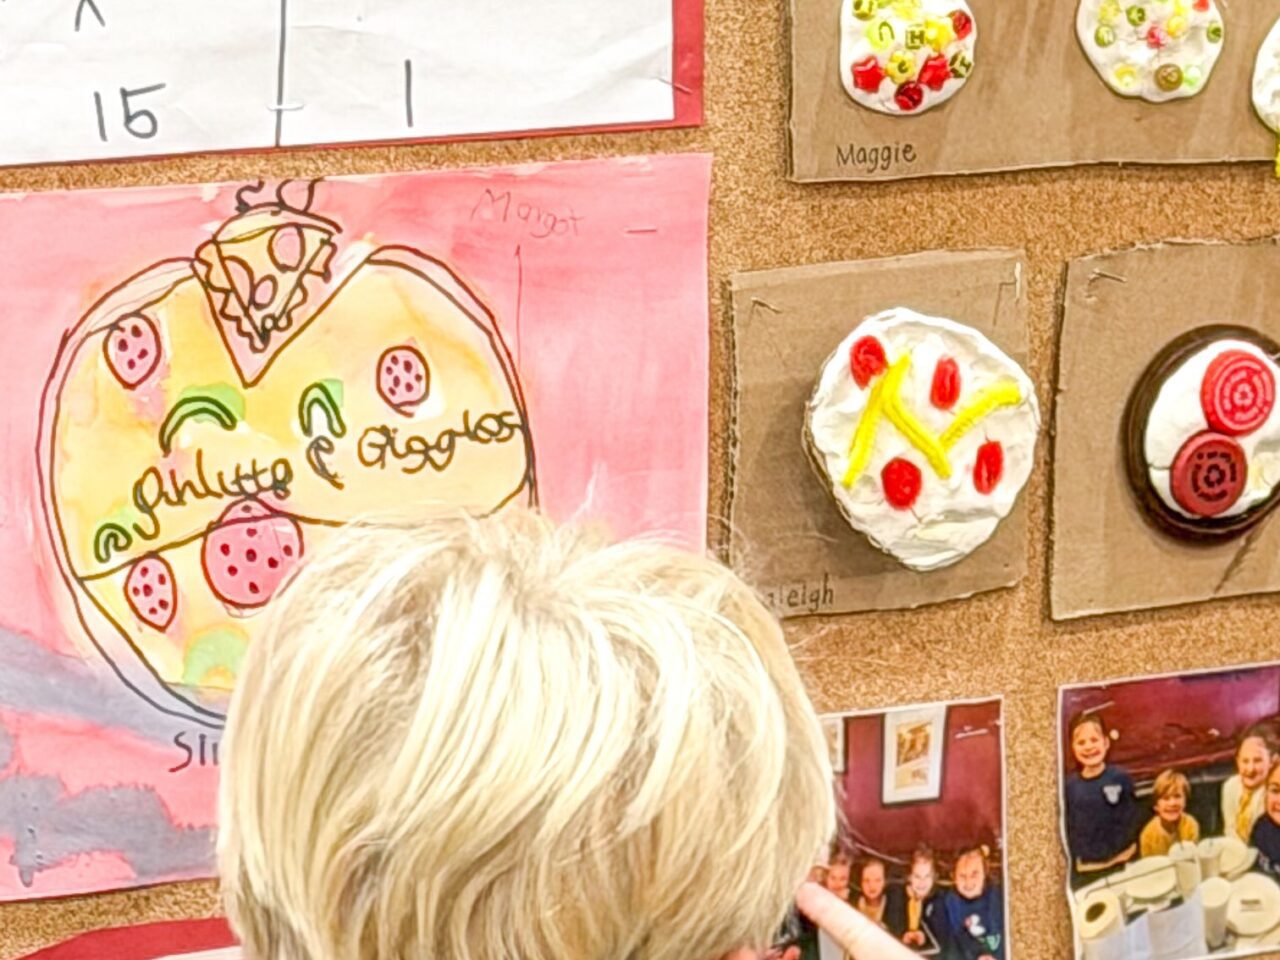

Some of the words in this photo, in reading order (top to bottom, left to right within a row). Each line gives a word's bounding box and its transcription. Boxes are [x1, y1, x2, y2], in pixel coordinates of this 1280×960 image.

[94, 83, 166, 139] 15
[835, 141, 917, 174] Maggie
[469, 187, 585, 239] Margot
